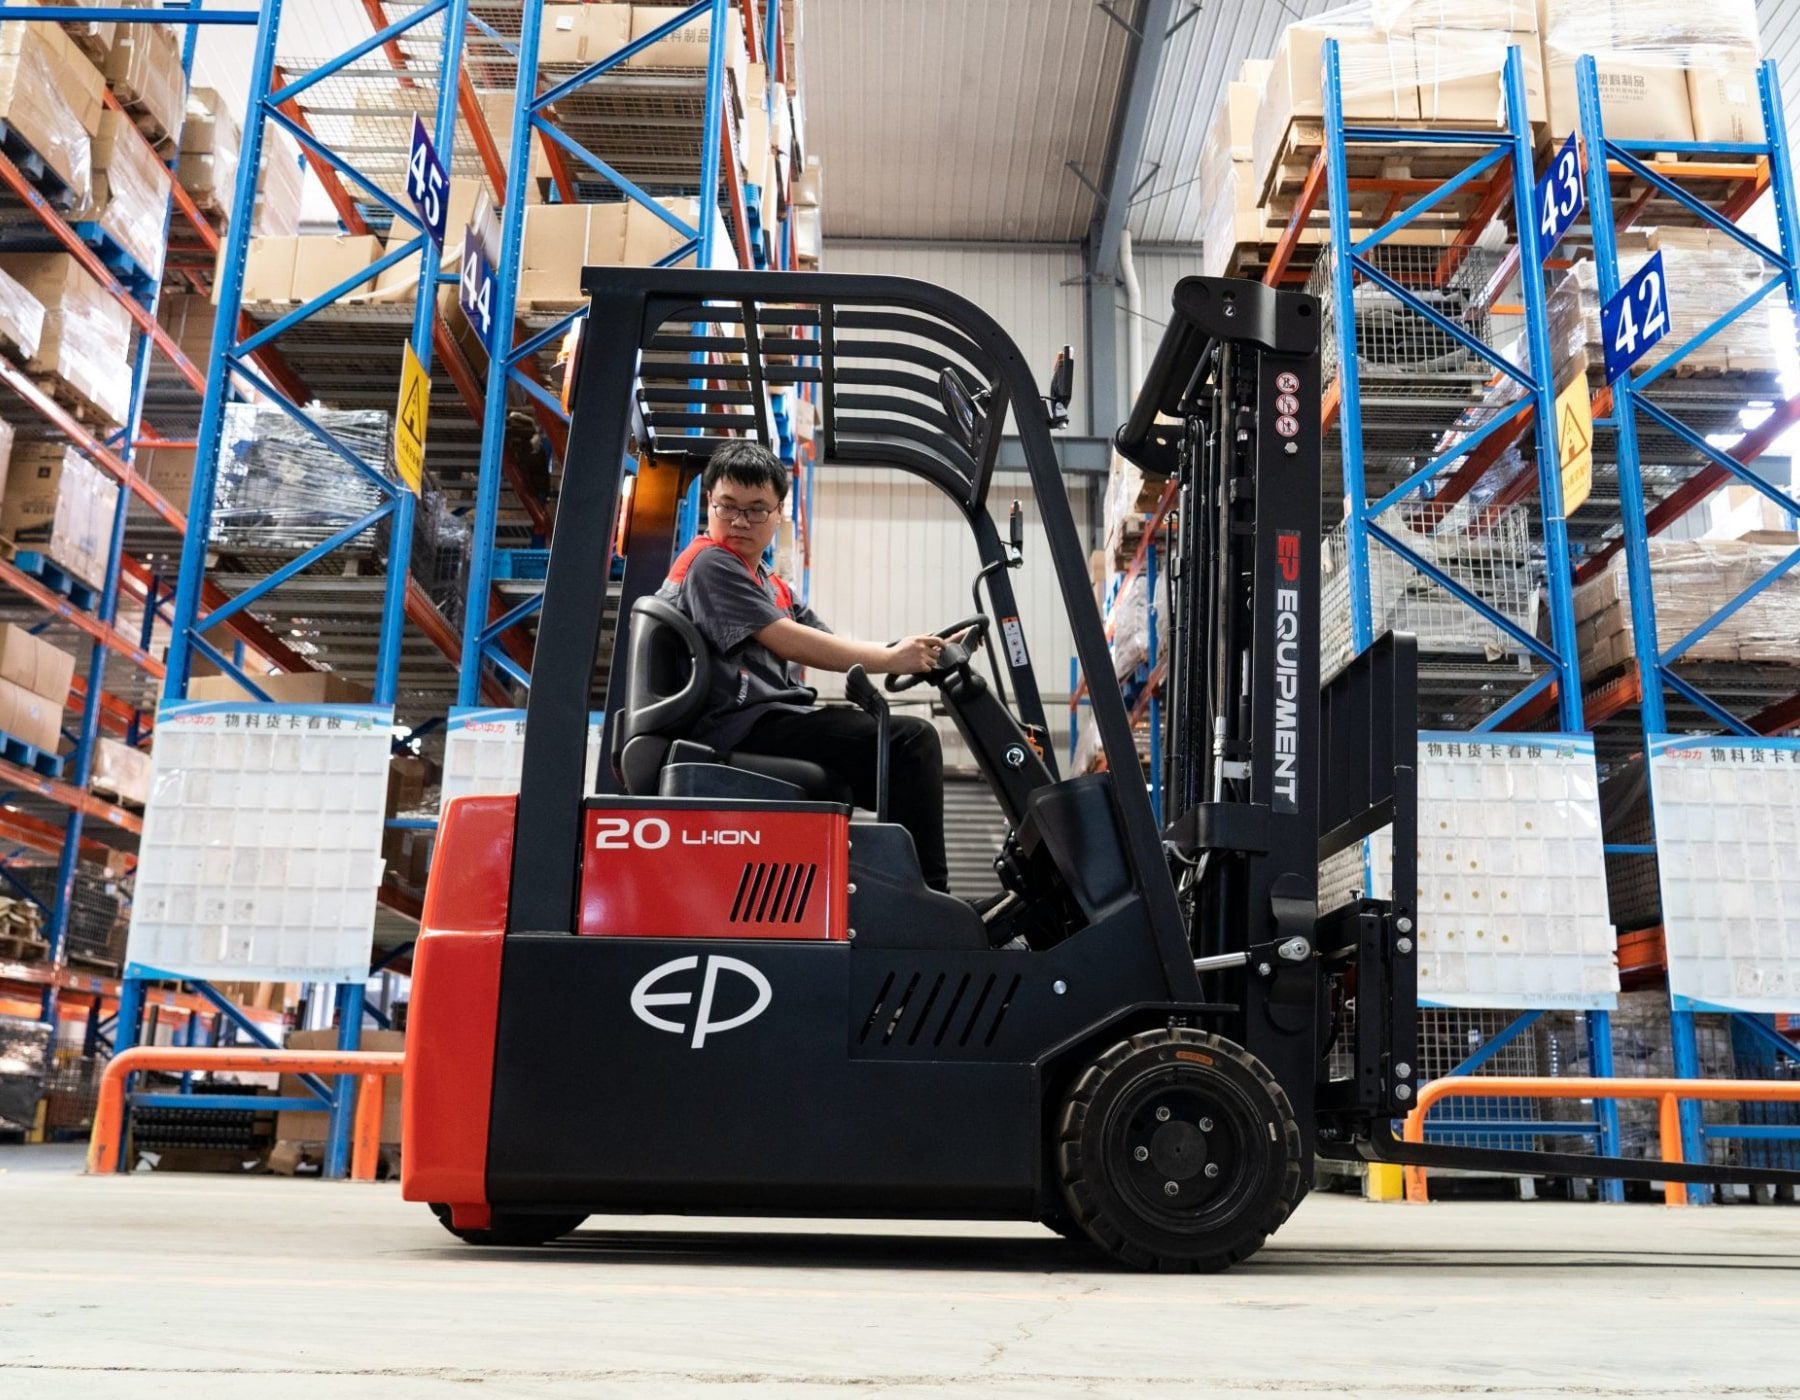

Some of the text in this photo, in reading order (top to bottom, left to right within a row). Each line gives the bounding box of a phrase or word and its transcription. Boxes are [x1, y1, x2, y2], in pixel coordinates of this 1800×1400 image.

[410, 143, 442, 226] 45
[1542, 151, 1579, 237] 43
[464, 252, 491, 334] 44
[1615, 271, 1665, 355] 42
[1274, 535, 1299, 804] EP EQUIPMENT
[225, 713, 342, 730] 物料货卡看板
[1428, 743, 1542, 759] 物料货卡看板
[596, 818, 671, 849] 20
[630, 955, 773, 1049] EP
